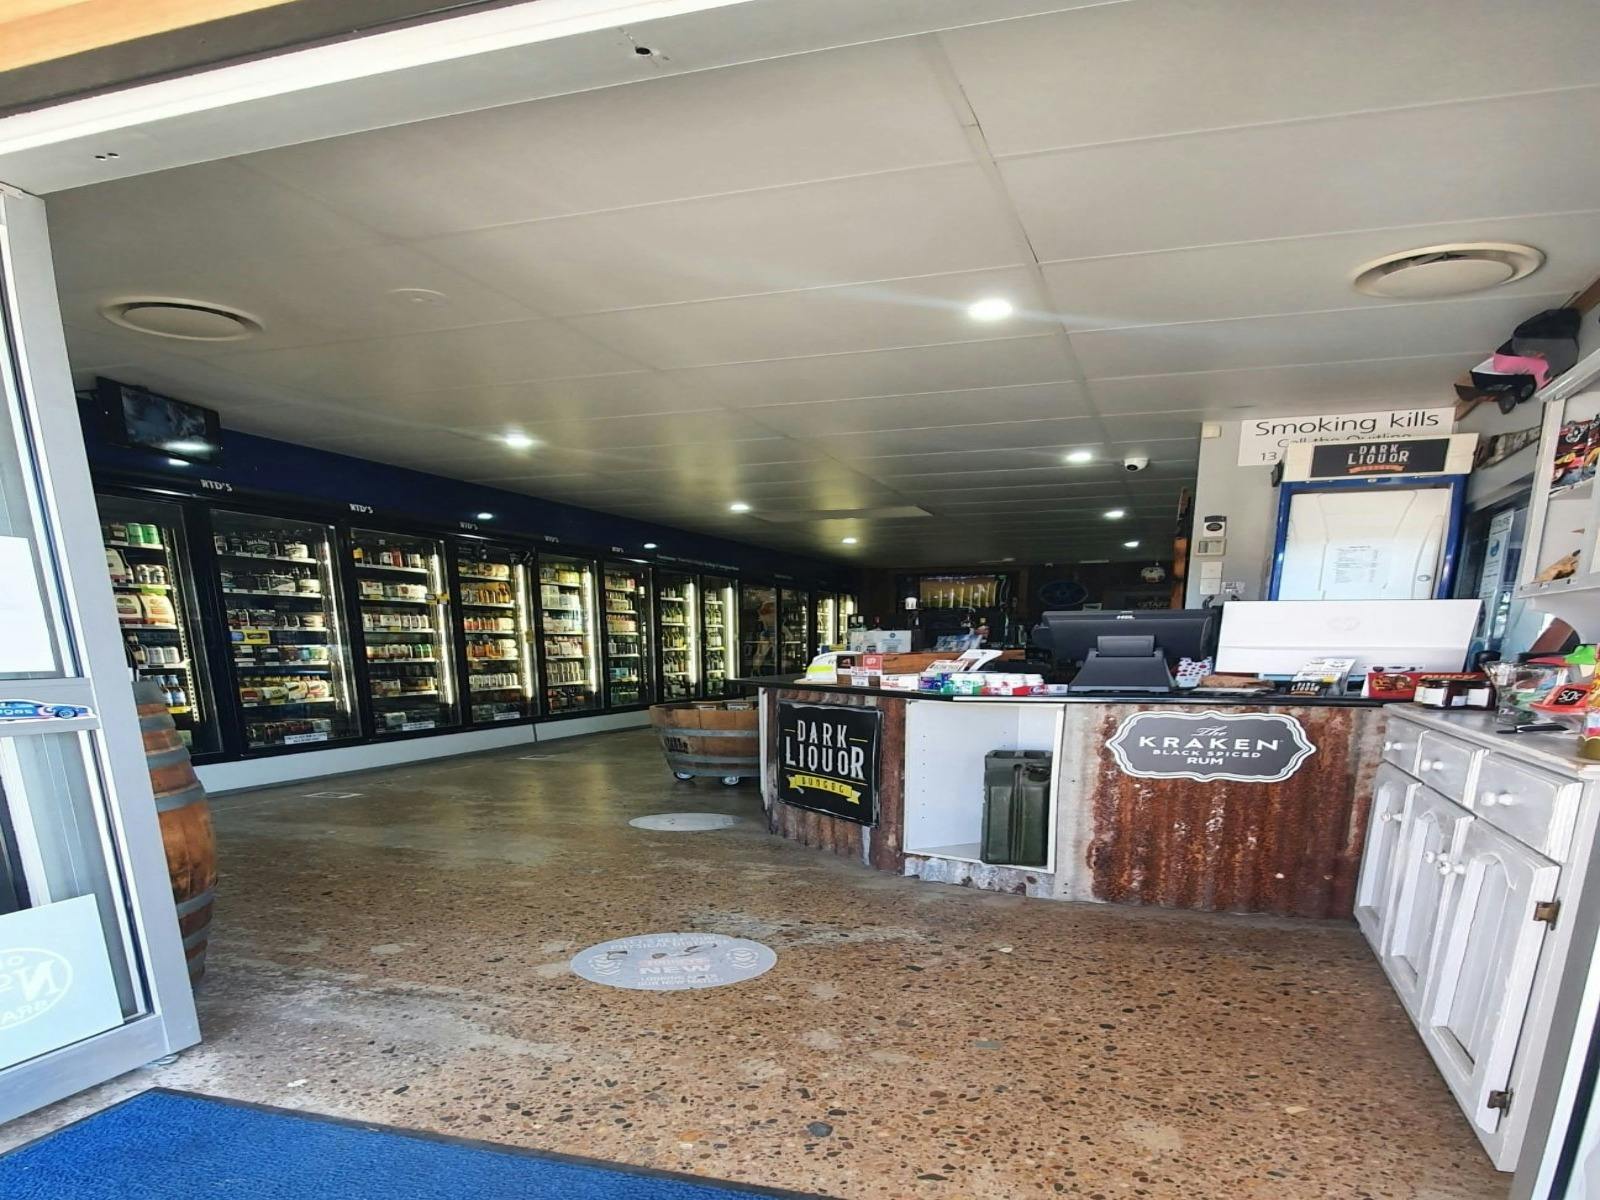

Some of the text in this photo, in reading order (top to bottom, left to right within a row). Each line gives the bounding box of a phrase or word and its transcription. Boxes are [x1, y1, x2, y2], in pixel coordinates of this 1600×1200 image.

[1255, 411, 1439, 436] Smoking kills
[1358, 443, 1400, 455] DARK
[1261, 451, 1277, 462] 13
[1347, 450, 1410, 465] LIQUOR
[200, 479, 233, 492] RTD'S
[349, 503, 374, 514] RTD'S
[797, 719, 848, 748] DARK
[1190, 725, 1228, 737] The
[1138, 736, 1279, 751] KRAKEN
[785, 736, 866, 780] LIQUOR
[1207, 750, 1261, 758] SPICED
[1187, 757, 1223, 766] RUM
[639, 964, 711, 975] NEW
